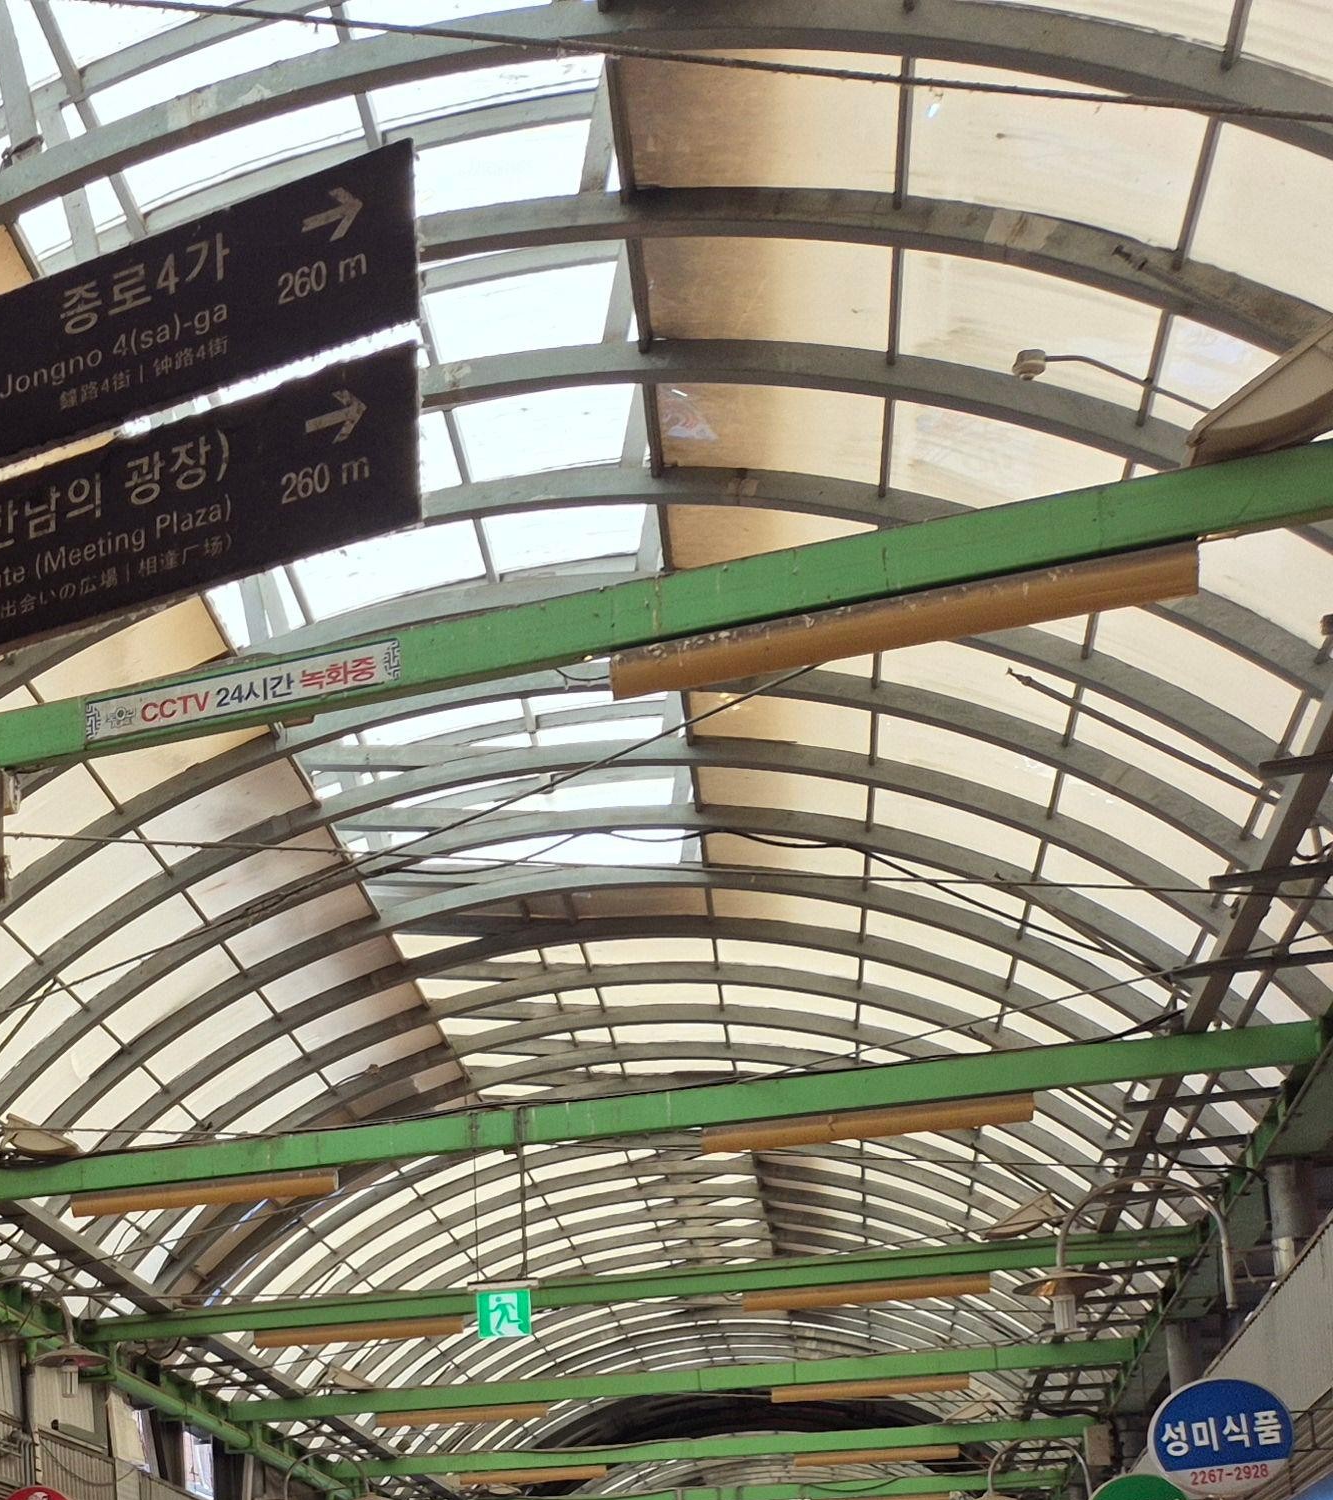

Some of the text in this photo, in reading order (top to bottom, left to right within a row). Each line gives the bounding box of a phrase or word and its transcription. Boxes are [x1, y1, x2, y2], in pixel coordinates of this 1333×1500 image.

[59, 231, 231, 337] 종로4가
[277, 251, 367, 305] 260 m
[0, 302, 228, 400] Jongno 4(sa)-ga
[124, 430, 231, 506] 광장)
[280, 456, 370, 504] 260 m
[35, 527, 146, 583] (Meeting
[156, 494, 232, 541] Plaza)
[140, 655, 378, 724] CCTV 24시간 녹화중
[1160, 1411, 1282, 1457] 성미식품
[1190, 1464, 1269, 1486] 2267-2928
